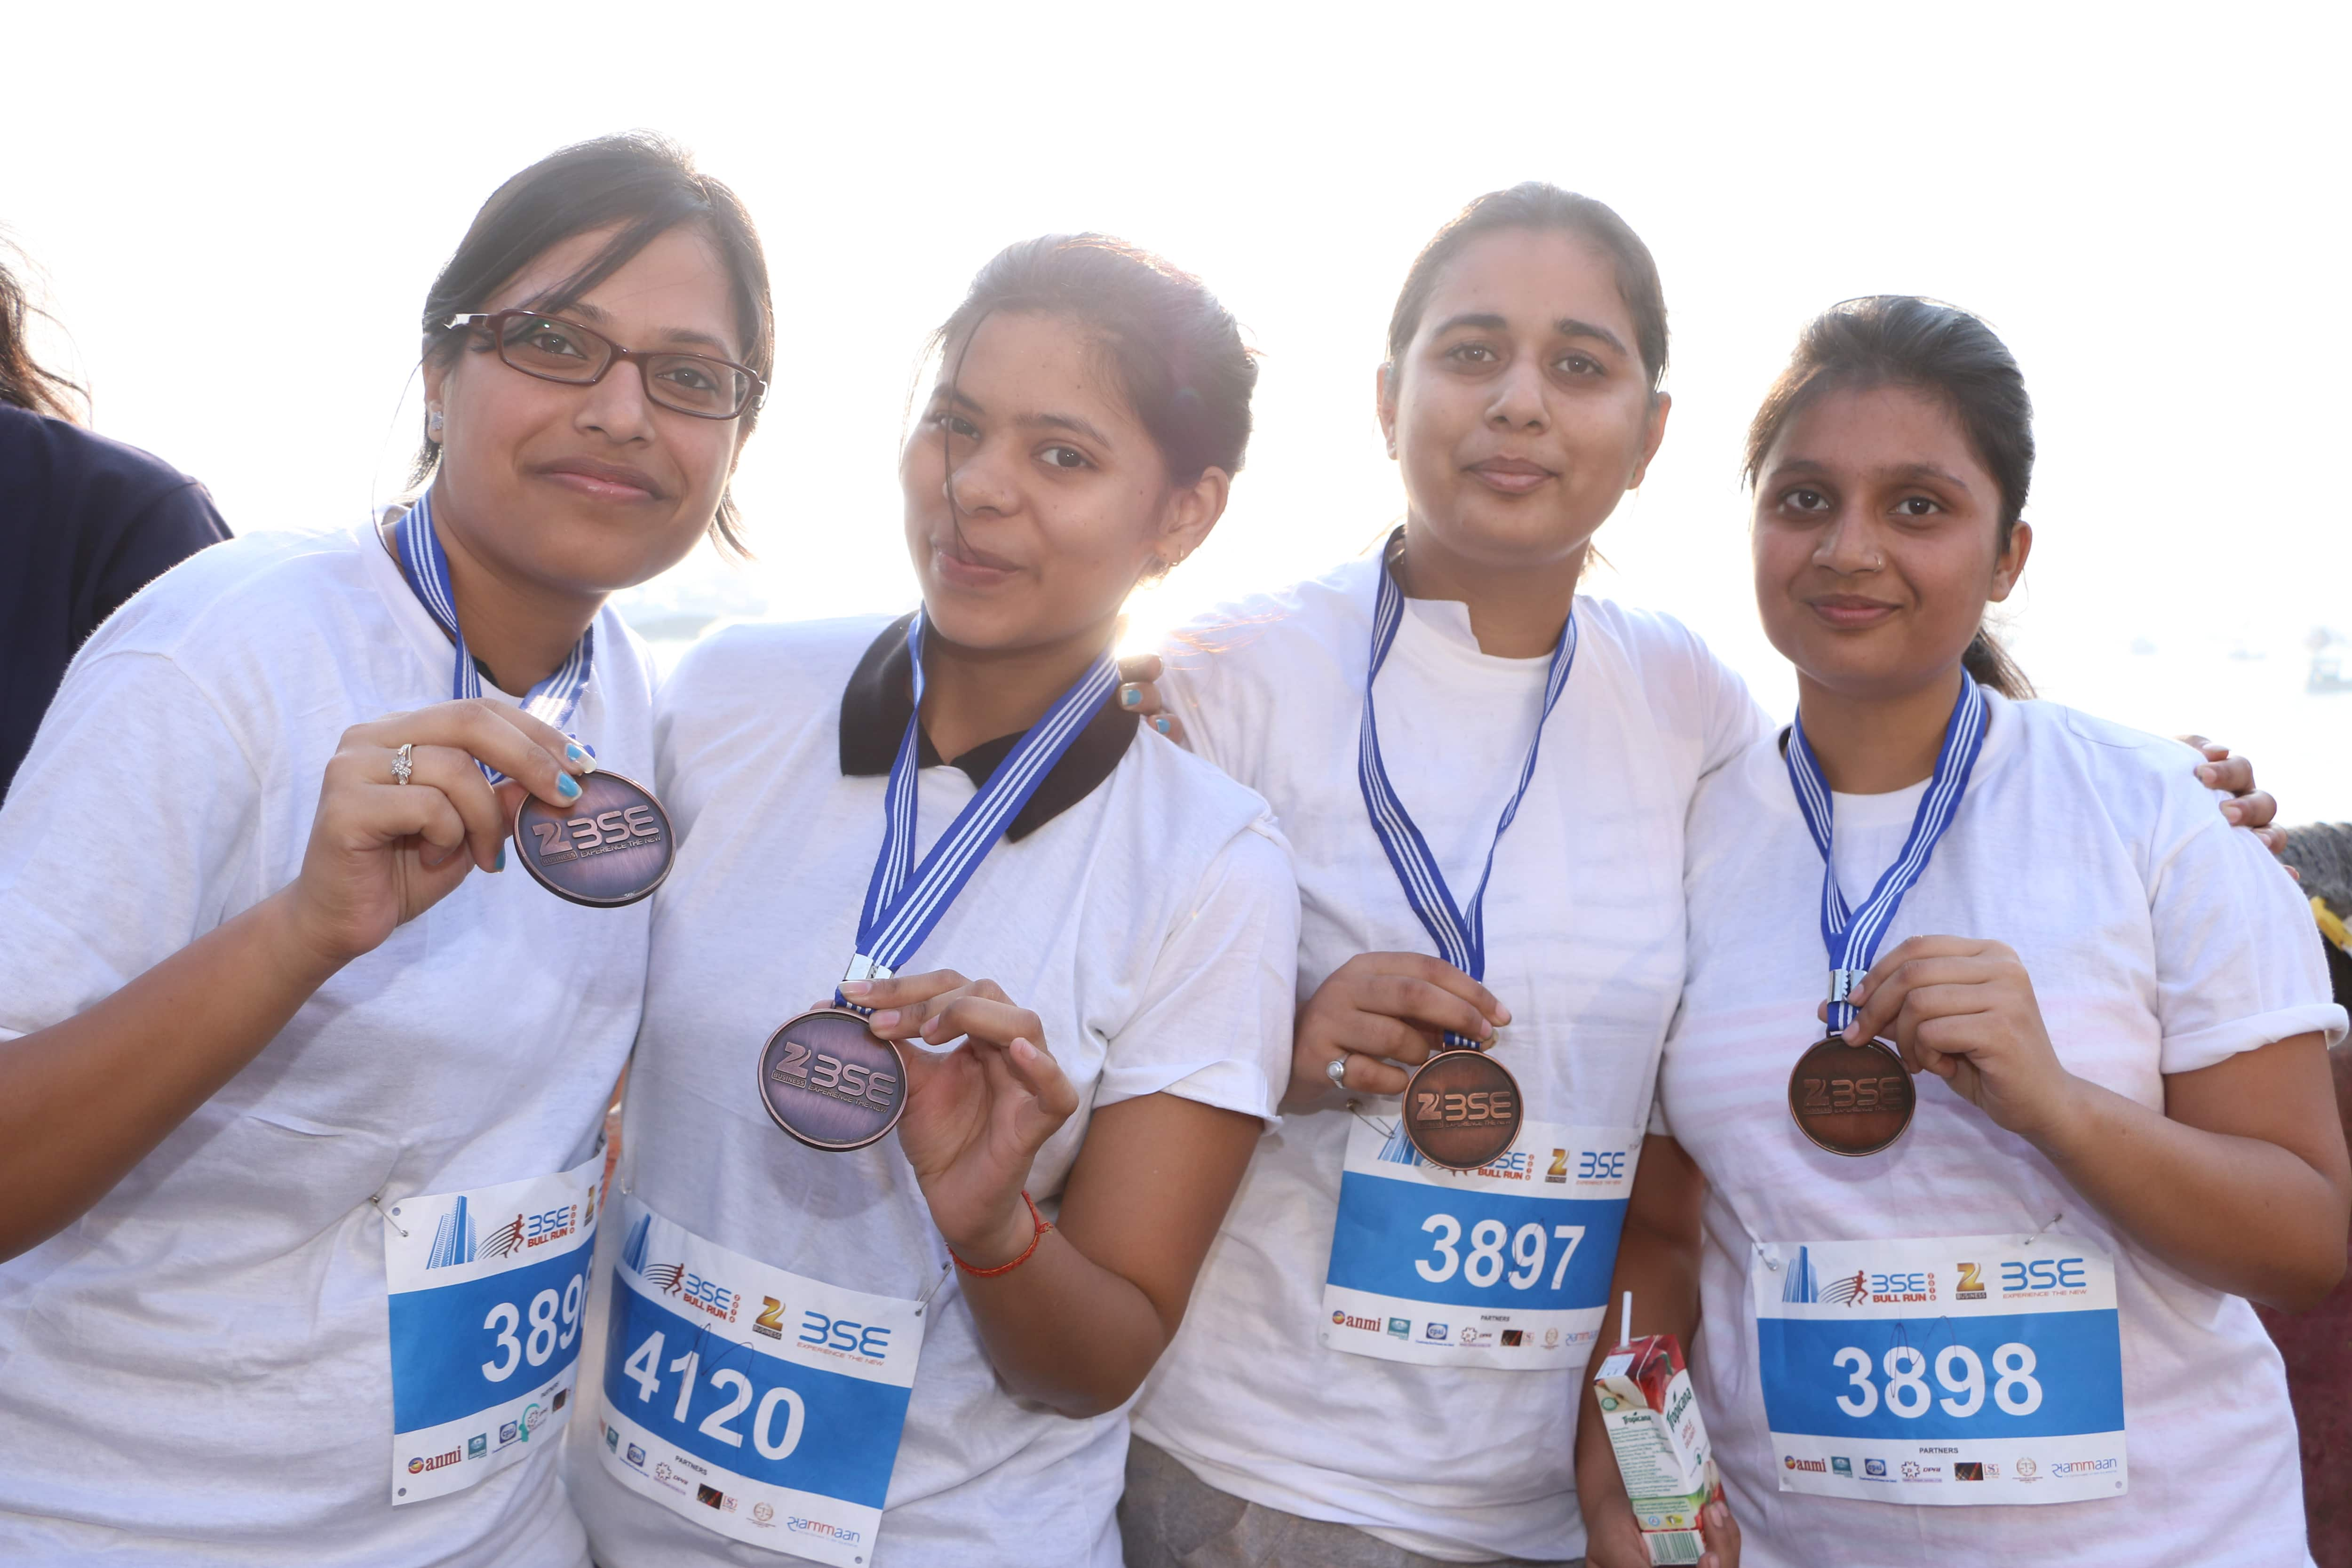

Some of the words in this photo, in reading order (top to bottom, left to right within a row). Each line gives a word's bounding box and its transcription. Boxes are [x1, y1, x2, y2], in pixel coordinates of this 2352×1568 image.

[567, 805, 659, 850] BSE
[543, 852, 576, 865] BUSINESS
[580, 843, 627, 858] EXPERIENCE
[644, 835, 661, 844] NEW
[773, 1072, 805, 1086] BUSINESS
[808, 1084, 853, 1103] EXPERIENCE
[855, 1098, 868, 1108] THE
[870, 1104, 888, 1113] NEW
[811, 1054, 896, 1106] BSE
[1831, 1077, 1901, 1106] BSE
[1445, 1091, 1512, 1121] BSE
[1478, 1168, 1501, 1178] BULL
[1503, 1170, 1523, 1180] RUN
[1487, 1151, 1526, 1170] SE
[1578, 1152, 1625, 1178] BSE
[528, 1206, 570, 1237] BSE
[527, 1234, 548, 1248] BULL
[550, 1227, 567, 1240] RUN
[1415, 1213, 1586, 1290] 3897
[1871, 1273, 1925, 1293] BSE
[2001, 1258, 2087, 1291] BSE
[685, 1273, 731, 1310] BSE
[1873, 1294, 1900, 1303] BULL
[1903, 1293, 1927, 1302] RUN
[683, 1293, 705, 1310] BULL
[707, 1304, 727, 1320] RUN
[753, 1324, 781, 1340] BUSINESS
[799, 1311, 891, 1359] BSE
[1346, 1315, 1382, 1332] anmi
[797, 1342, 845, 1358] EXPERIENCE
[1833, 1342, 2043, 1418] 3898
[624, 1331, 805, 1460] 4120
[1622, 1411, 1652, 1425] Tropicana
[1667, 1387, 1692, 1433] Tropicana
[426, 1445, 461, 1472] anmi
[675, 1455, 707, 1476] PARTNERS
[1796, 1458, 1827, 1472] anmi
